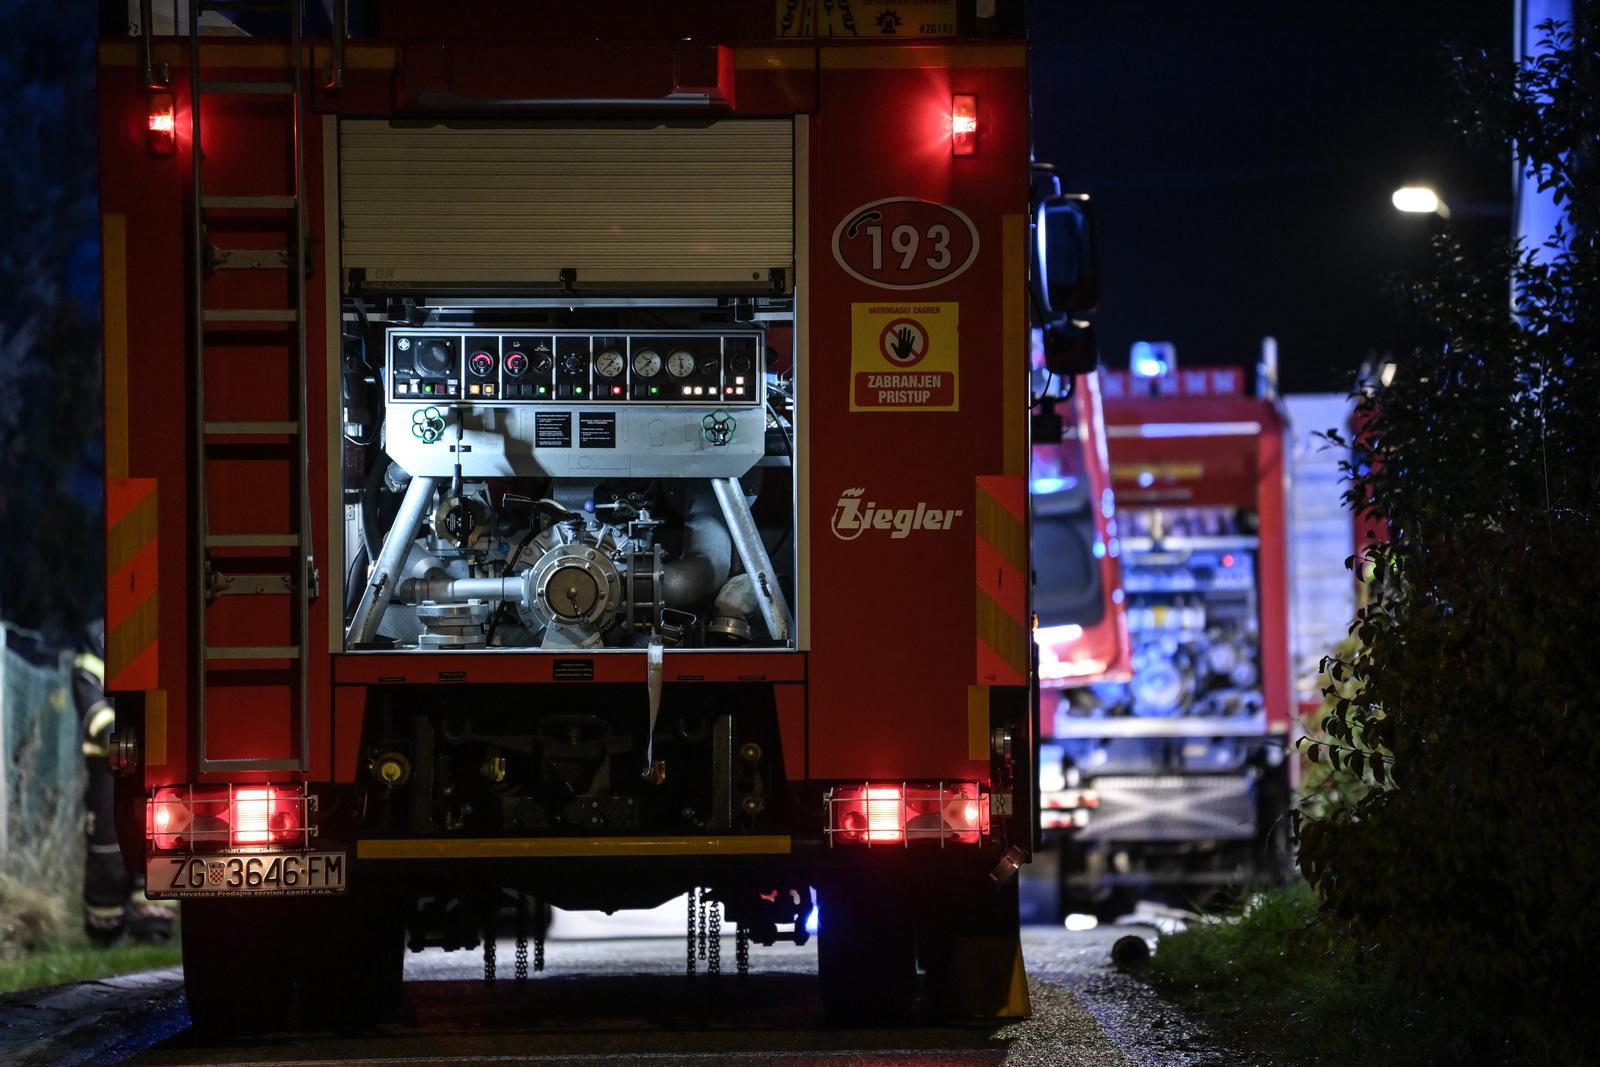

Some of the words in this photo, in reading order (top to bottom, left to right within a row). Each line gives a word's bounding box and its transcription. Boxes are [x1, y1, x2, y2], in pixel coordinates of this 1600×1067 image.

[867, 224, 952, 270] 193
[868, 306, 911, 314] VATROGASCI
[913, 306, 941, 314] ZAGREB
[867, 375, 941, 388] ZABRANJEN
[878, 390, 931, 403] PRISTUP
[831, 496, 963, 540] Ziegler
[170, 858, 206, 888] ZG
[217, 890, 252, 898] Prodajno
